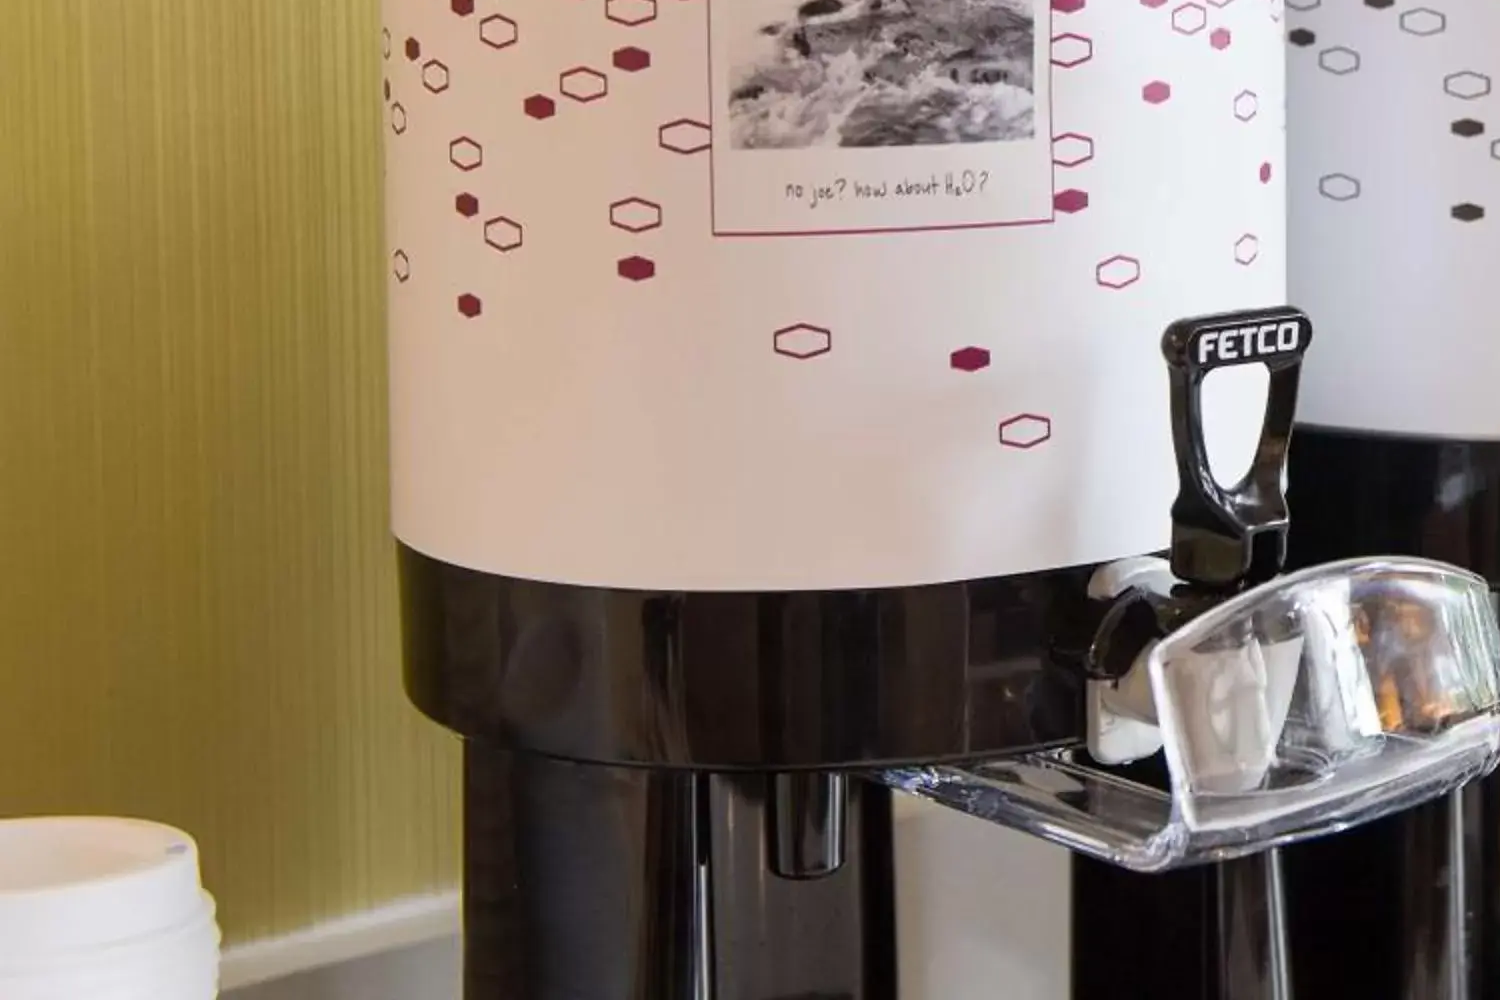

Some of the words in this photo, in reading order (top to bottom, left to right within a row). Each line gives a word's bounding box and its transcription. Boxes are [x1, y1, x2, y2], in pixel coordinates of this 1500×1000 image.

[785, 182, 804, 198] no
[809, 177, 848, 209] joe?
[854, 180, 888, 198] how
[895, 174, 940, 196] about
[1198, 321, 1300, 364] FETCO
